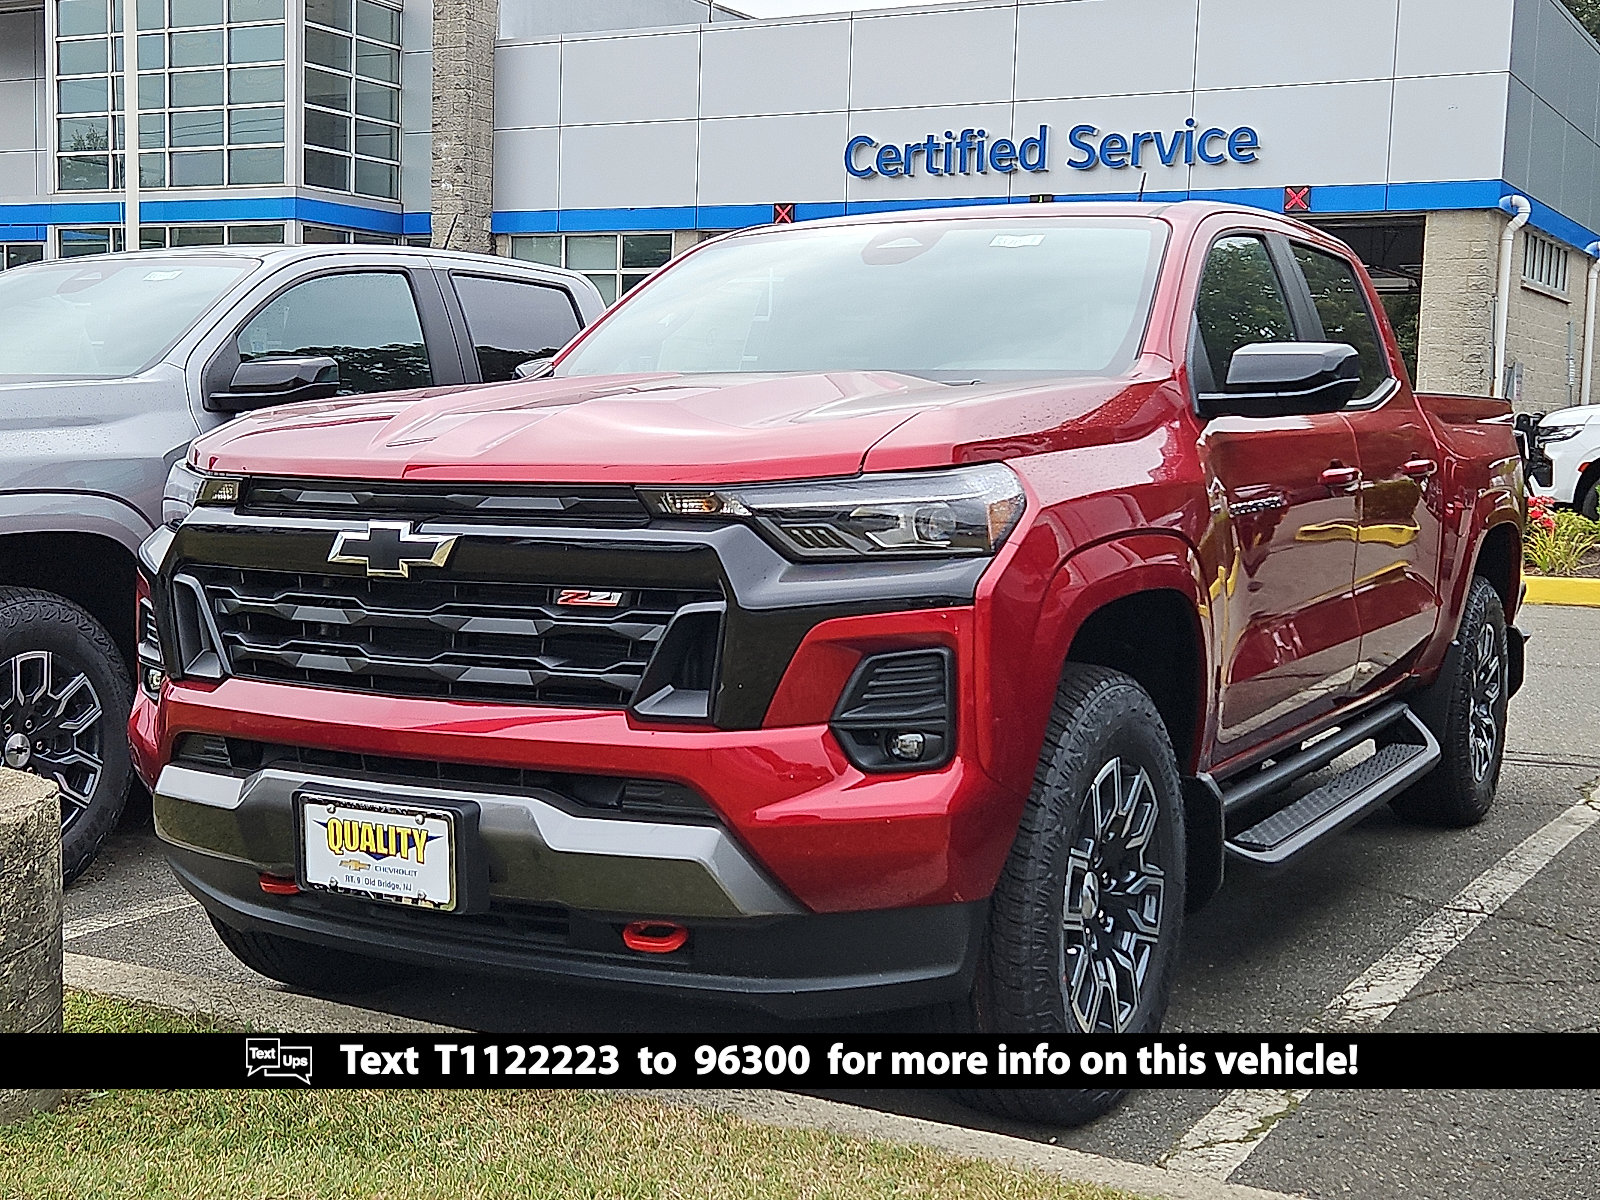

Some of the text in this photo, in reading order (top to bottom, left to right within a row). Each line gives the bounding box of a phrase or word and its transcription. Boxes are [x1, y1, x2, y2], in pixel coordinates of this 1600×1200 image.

[844, 118, 1258, 178] Certified Service
[326, 817, 429, 865] QUALITY
[364, 877, 376, 887] Old
[377, 879, 402, 892] Bridge,
[403, 883, 412, 892] NJ
[374, 865, 418, 877] CHEVROLET
